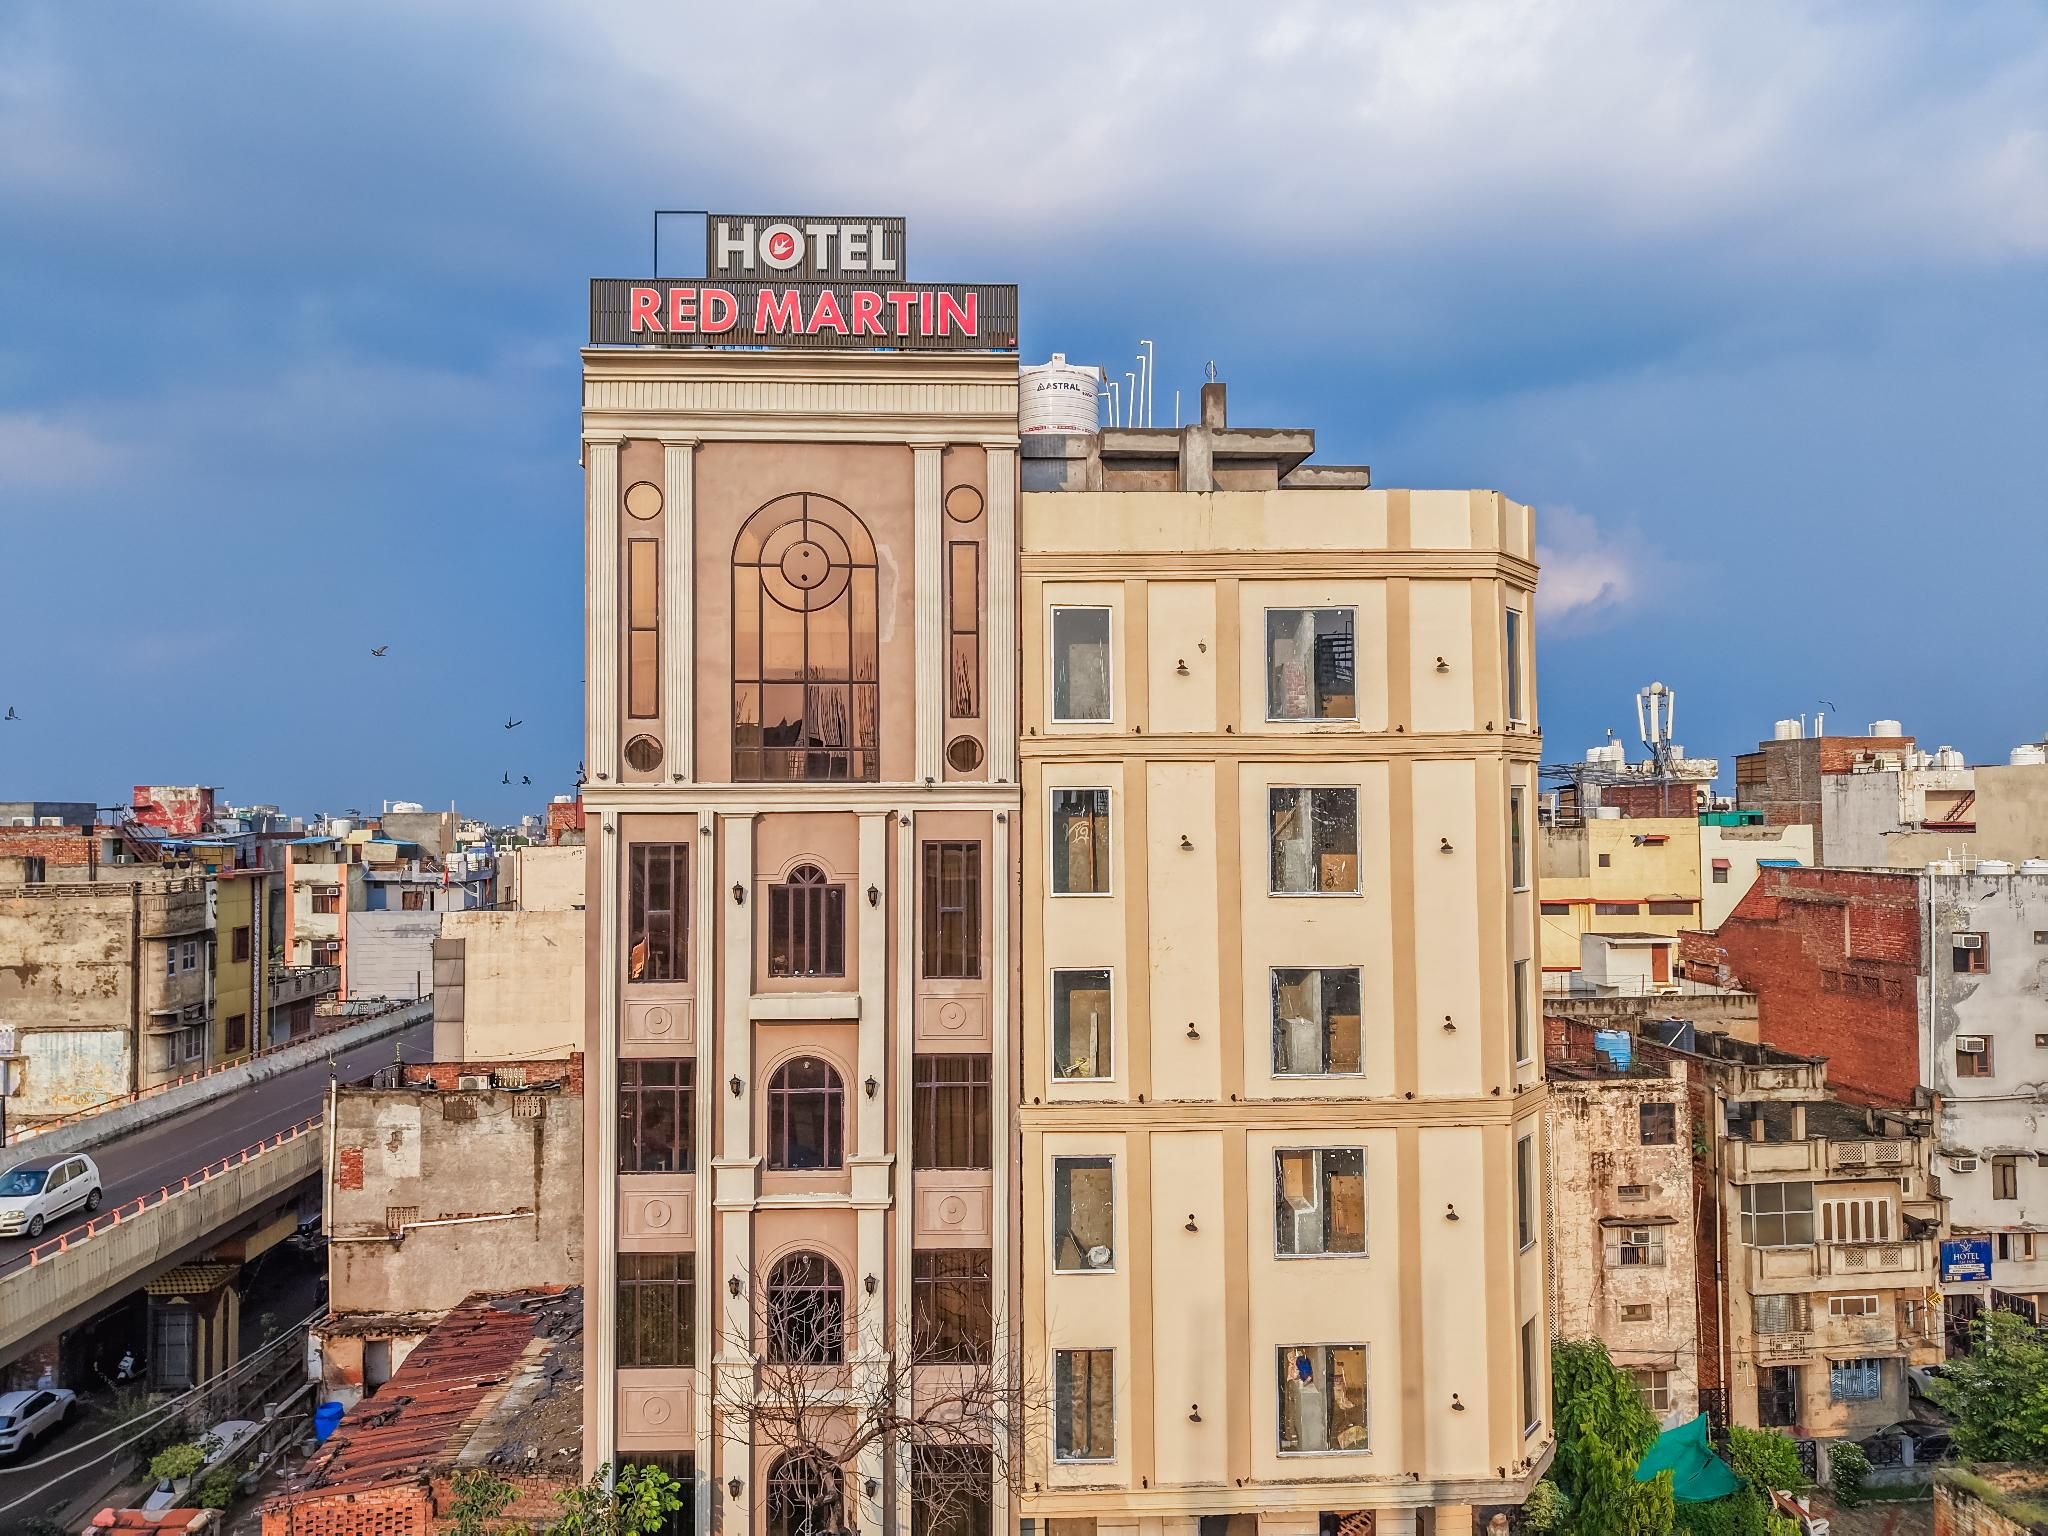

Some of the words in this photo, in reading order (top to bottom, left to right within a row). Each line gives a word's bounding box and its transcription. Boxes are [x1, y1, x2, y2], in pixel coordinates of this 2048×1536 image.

[717, 222, 897, 271] HOTEL
[630, 287, 739, 334] RED
[753, 288, 978, 336] MARTIN
[1046, 382, 1080, 391] ASTRAL
[1953, 1252, 1979, 1261] HOTEL
